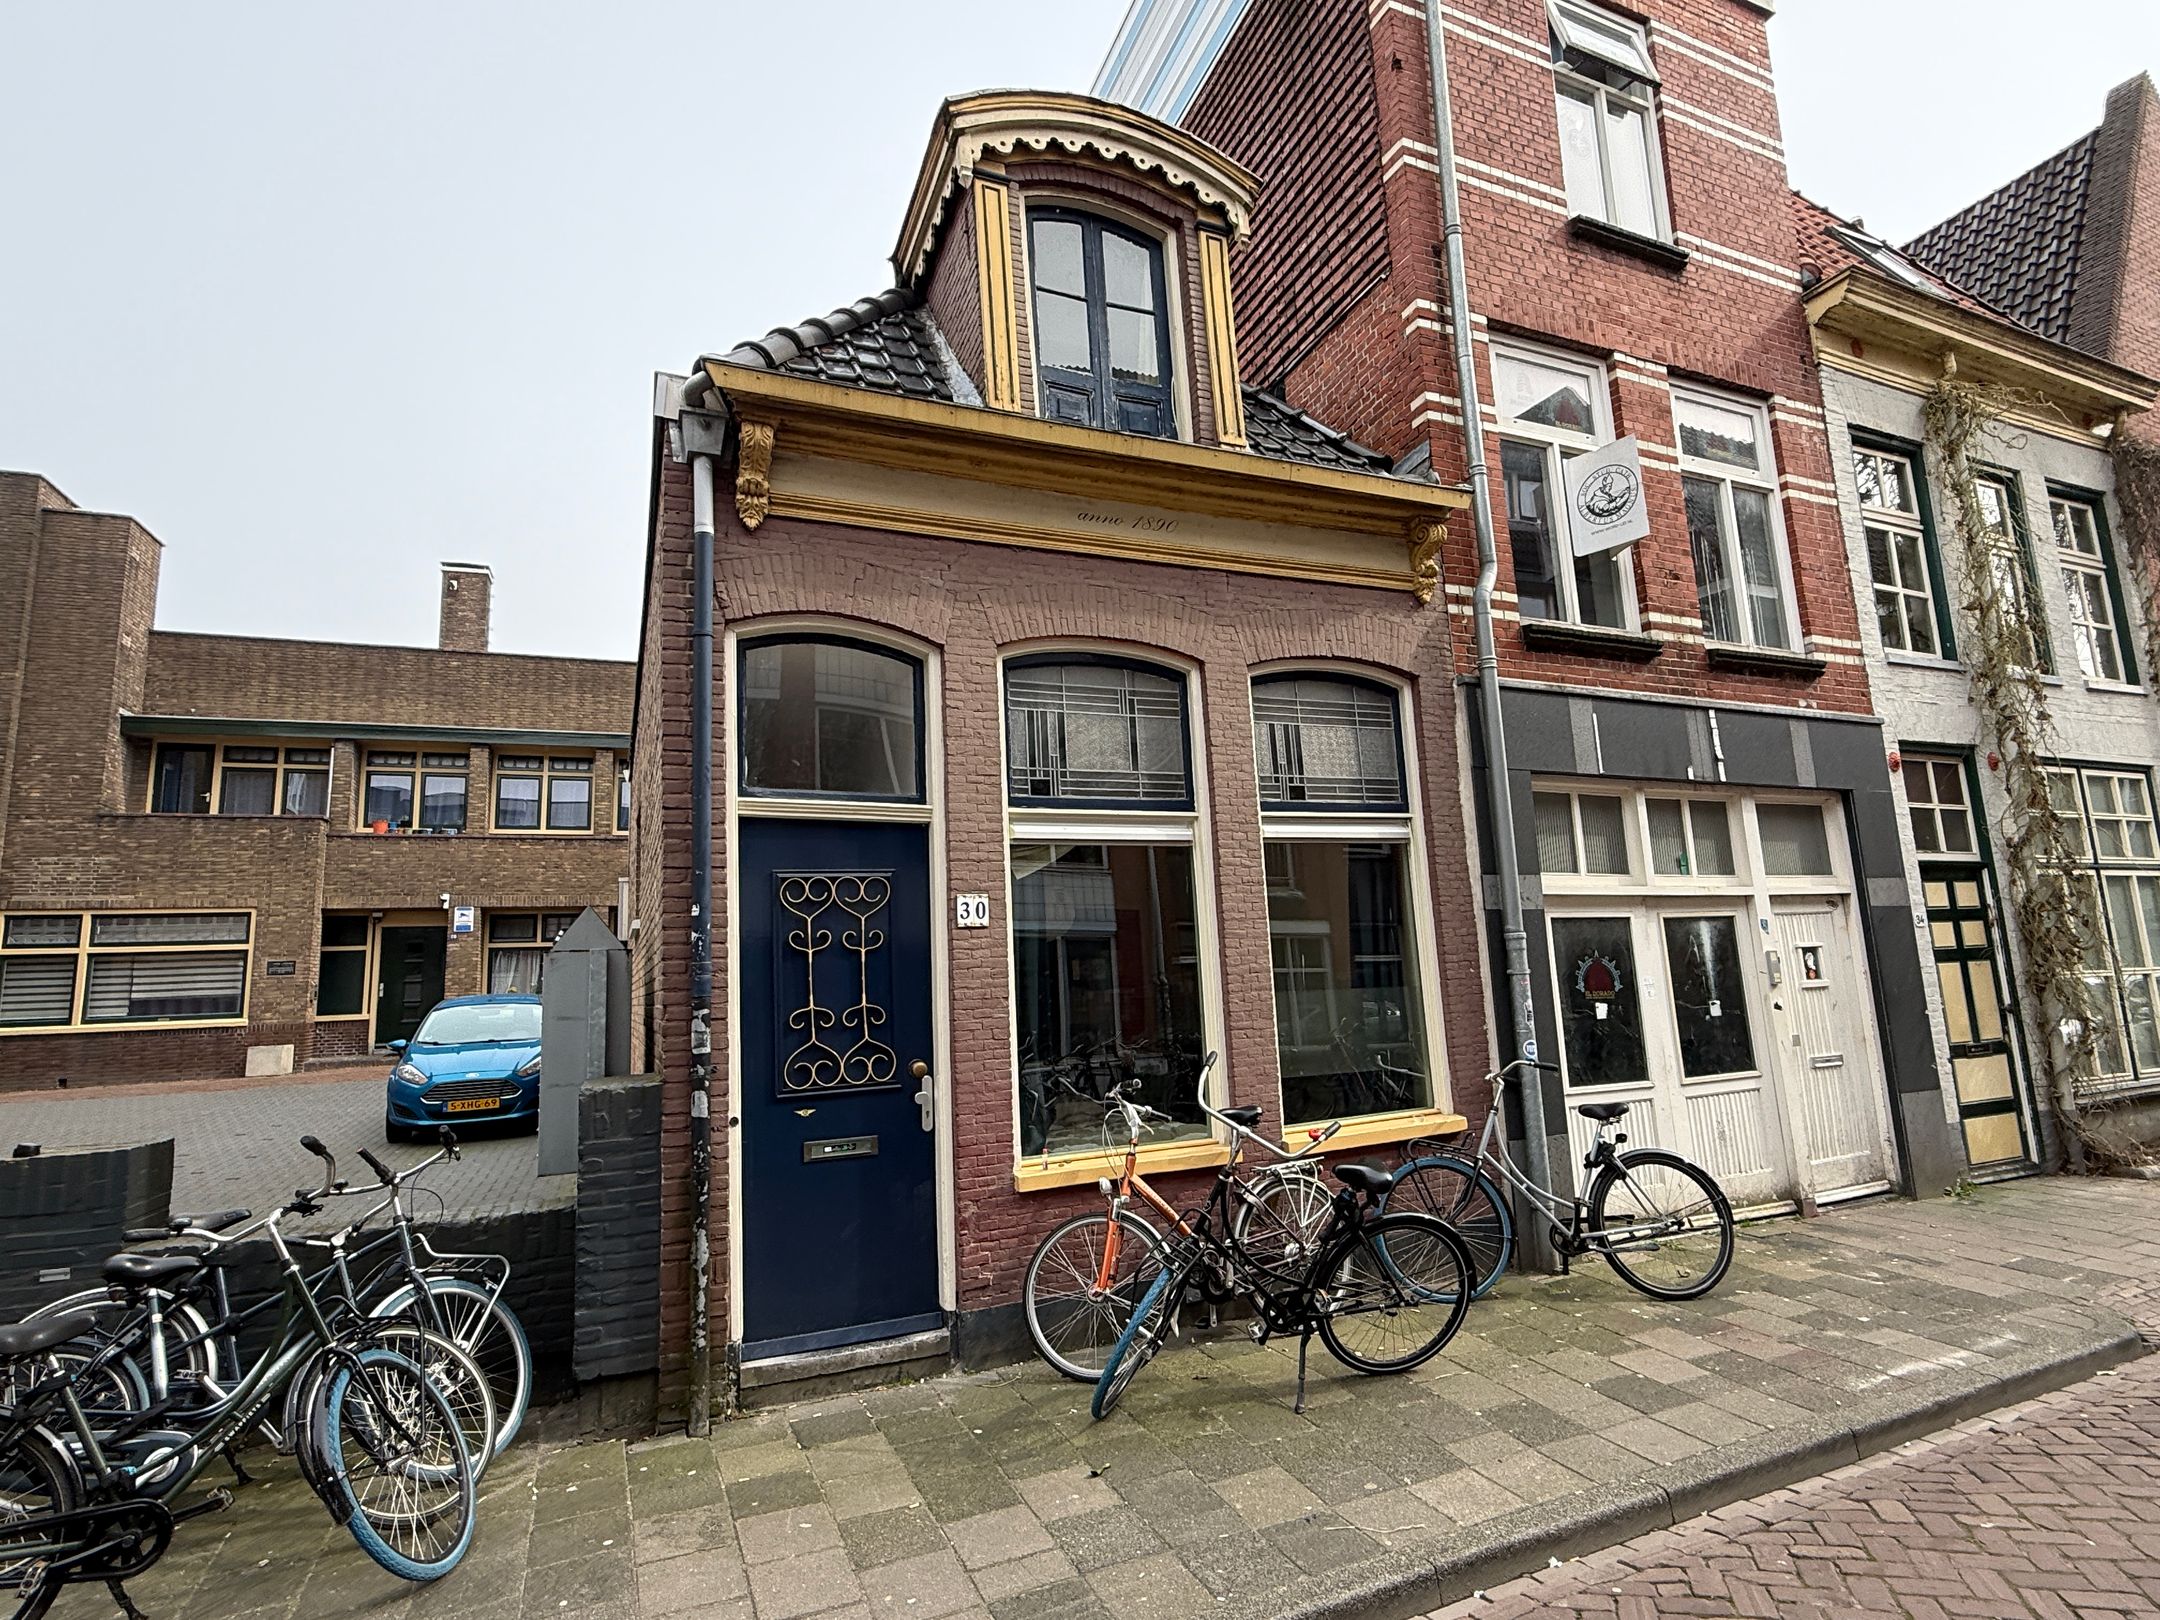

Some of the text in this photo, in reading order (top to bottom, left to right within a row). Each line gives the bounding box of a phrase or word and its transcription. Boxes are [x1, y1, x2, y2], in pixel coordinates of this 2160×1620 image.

[1077, 511, 1180, 533] anno 1890
[1578, 503, 1615, 524] ALBERTUS
[959, 901, 986, 920] 30
[1915, 914, 1925, 925] 34
[450, 1098, 498, 1111] 5-XHG-69
